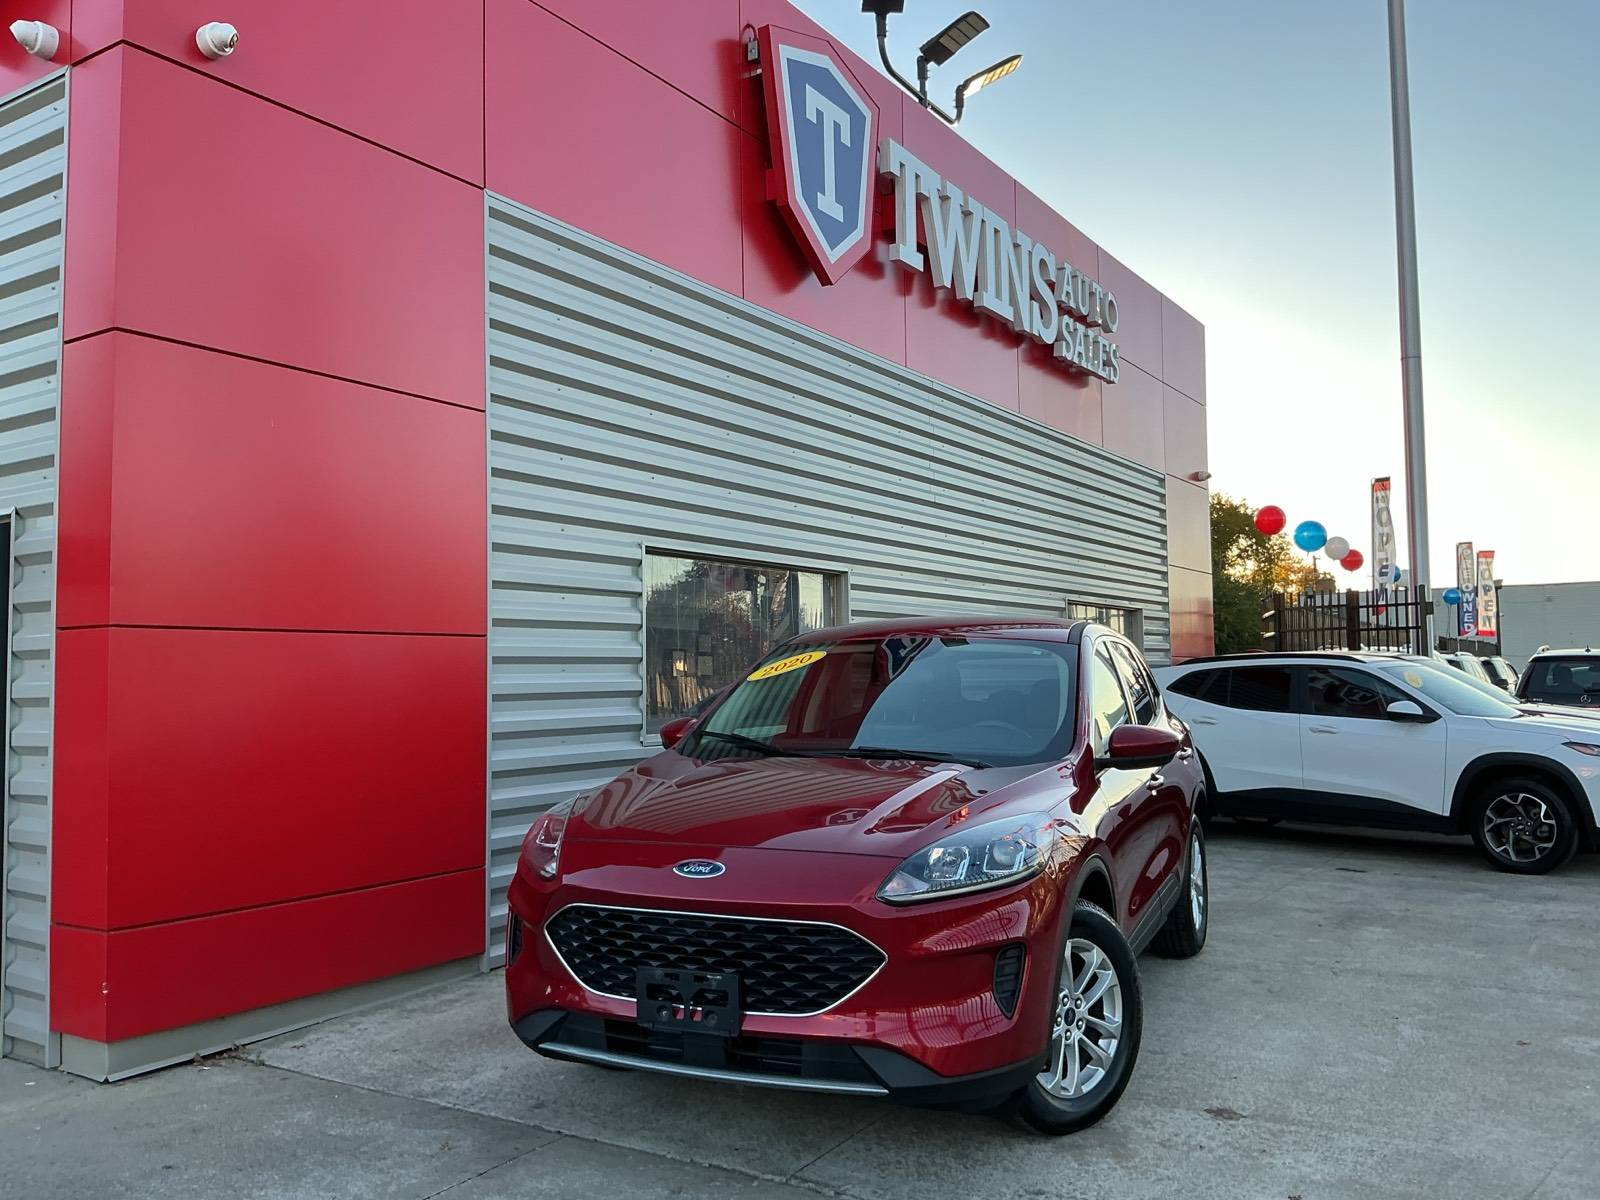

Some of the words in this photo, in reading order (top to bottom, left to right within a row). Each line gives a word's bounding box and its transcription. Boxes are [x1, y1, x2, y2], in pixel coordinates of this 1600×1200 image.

[805, 83, 851, 223] T
[880, 137, 1059, 345] TWINS
[1056, 261, 1119, 333] AUTO
[1054, 314, 1120, 384] SALES
[1480, 566, 1494, 629] OPEN
[760, 654, 813, 678] 2020
[683, 861, 714, 874] Ford
